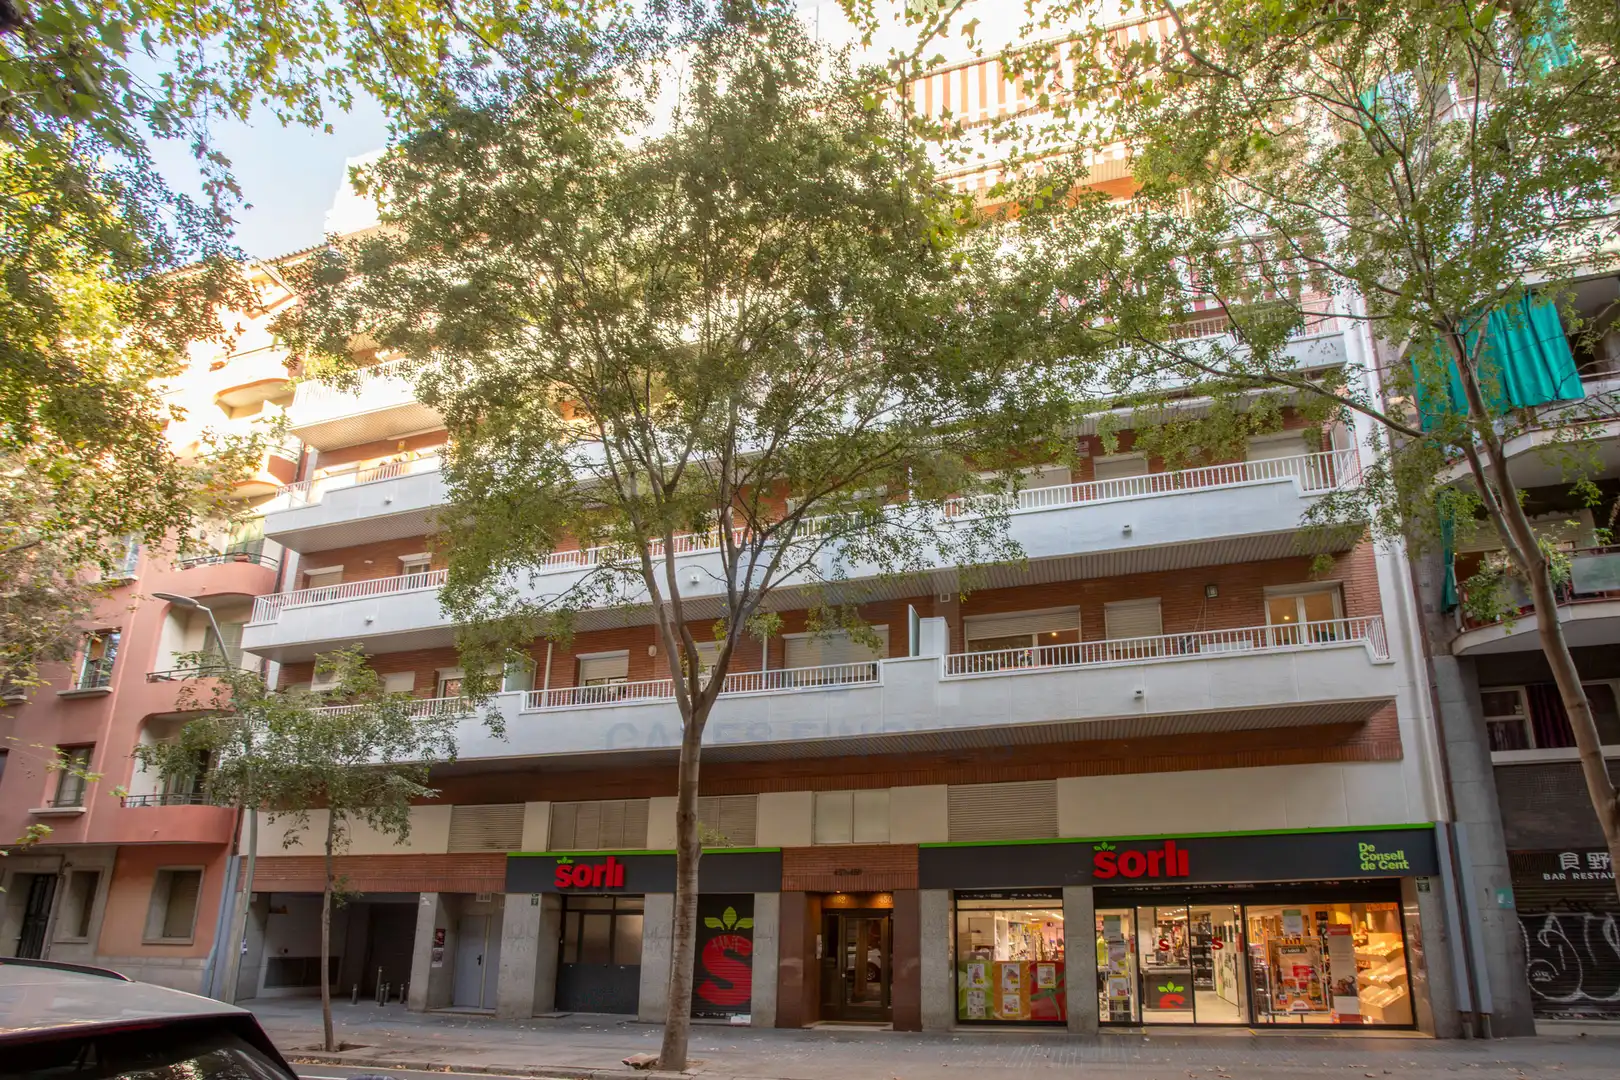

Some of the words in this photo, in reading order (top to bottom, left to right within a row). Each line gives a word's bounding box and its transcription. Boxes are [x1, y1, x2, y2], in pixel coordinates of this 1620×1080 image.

[1358, 842, 1376, 852] De
[1092, 841, 1190, 879] sorli
[1360, 850, 1405, 861] Consell
[1361, 861, 1377, 870] de
[1378, 860, 1410, 870] Cent
[554, 856, 625, 888] sorli
